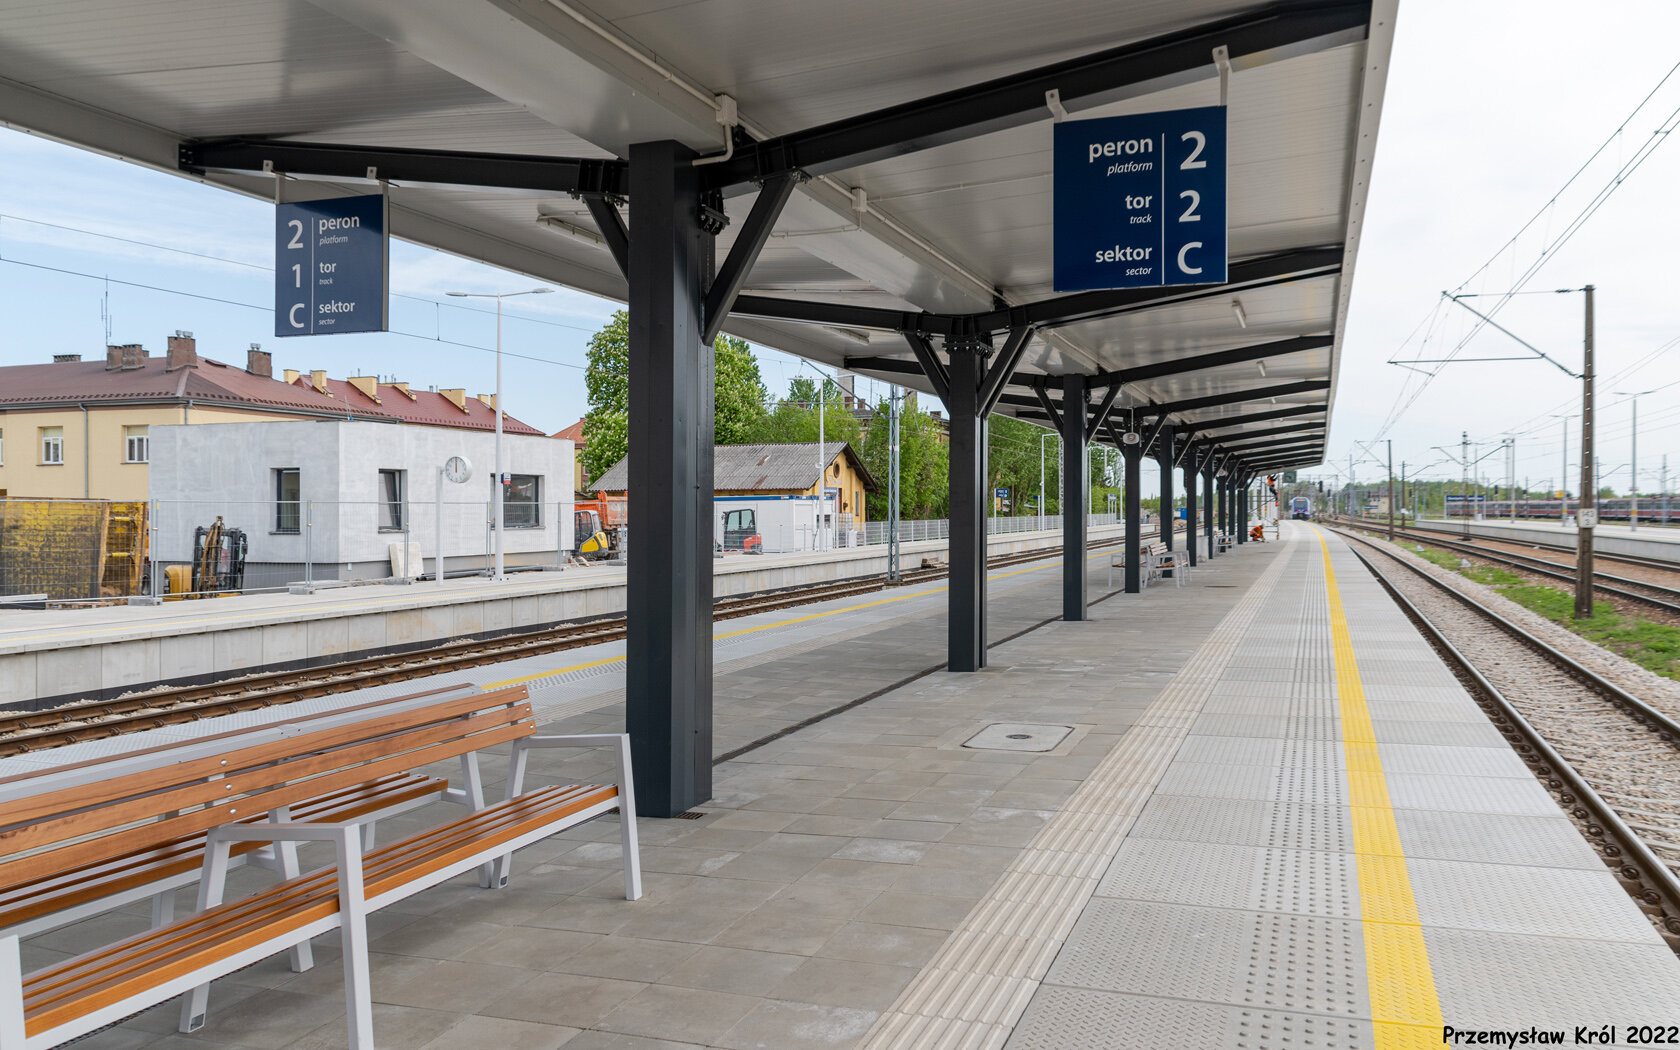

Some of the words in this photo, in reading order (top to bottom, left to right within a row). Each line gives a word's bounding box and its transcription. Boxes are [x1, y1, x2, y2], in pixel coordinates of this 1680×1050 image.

[1089, 138, 1153, 163] peron
[1180, 130, 1207, 170] 2
[1107, 161, 1153, 176] platform
[1125, 194, 1153, 209] tor
[1178, 189, 1201, 223] 2
[1129, 213, 1152, 224] track
[287, 219, 304, 250] 2
[319, 216, 360, 235] peron
[319, 235, 349, 246] platform
[1095, 245, 1153, 263] sektor
[1177, 241, 1203, 275] C
[292, 263, 301, 288] 1
[319, 262, 337, 273] tor
[319, 277, 333, 285] track
[1125, 266, 1152, 276] sector
[289, 303, 305, 329] C
[318, 300, 356, 314] sektor
[318, 318, 336, 326] sector
